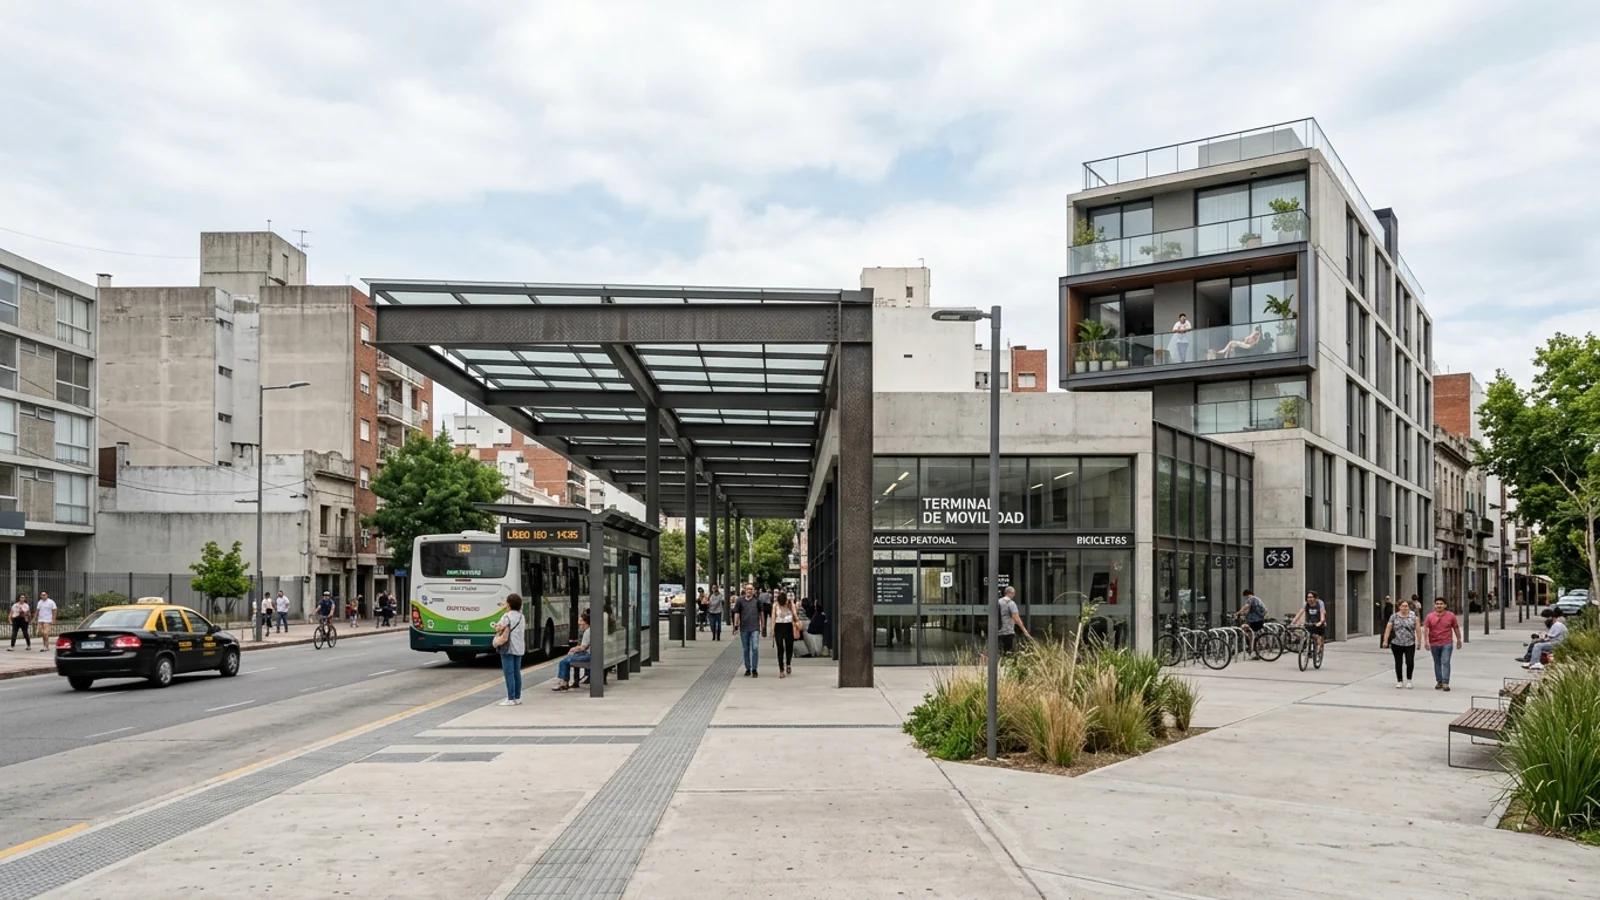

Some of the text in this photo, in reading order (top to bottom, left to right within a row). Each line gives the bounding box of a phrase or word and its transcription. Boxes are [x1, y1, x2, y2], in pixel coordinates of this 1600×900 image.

[922, 497, 992, 510] TERMINAL
[923, 511, 1025, 524] DE MOVILDAD
[910, 535, 958, 545] PEATONAL
